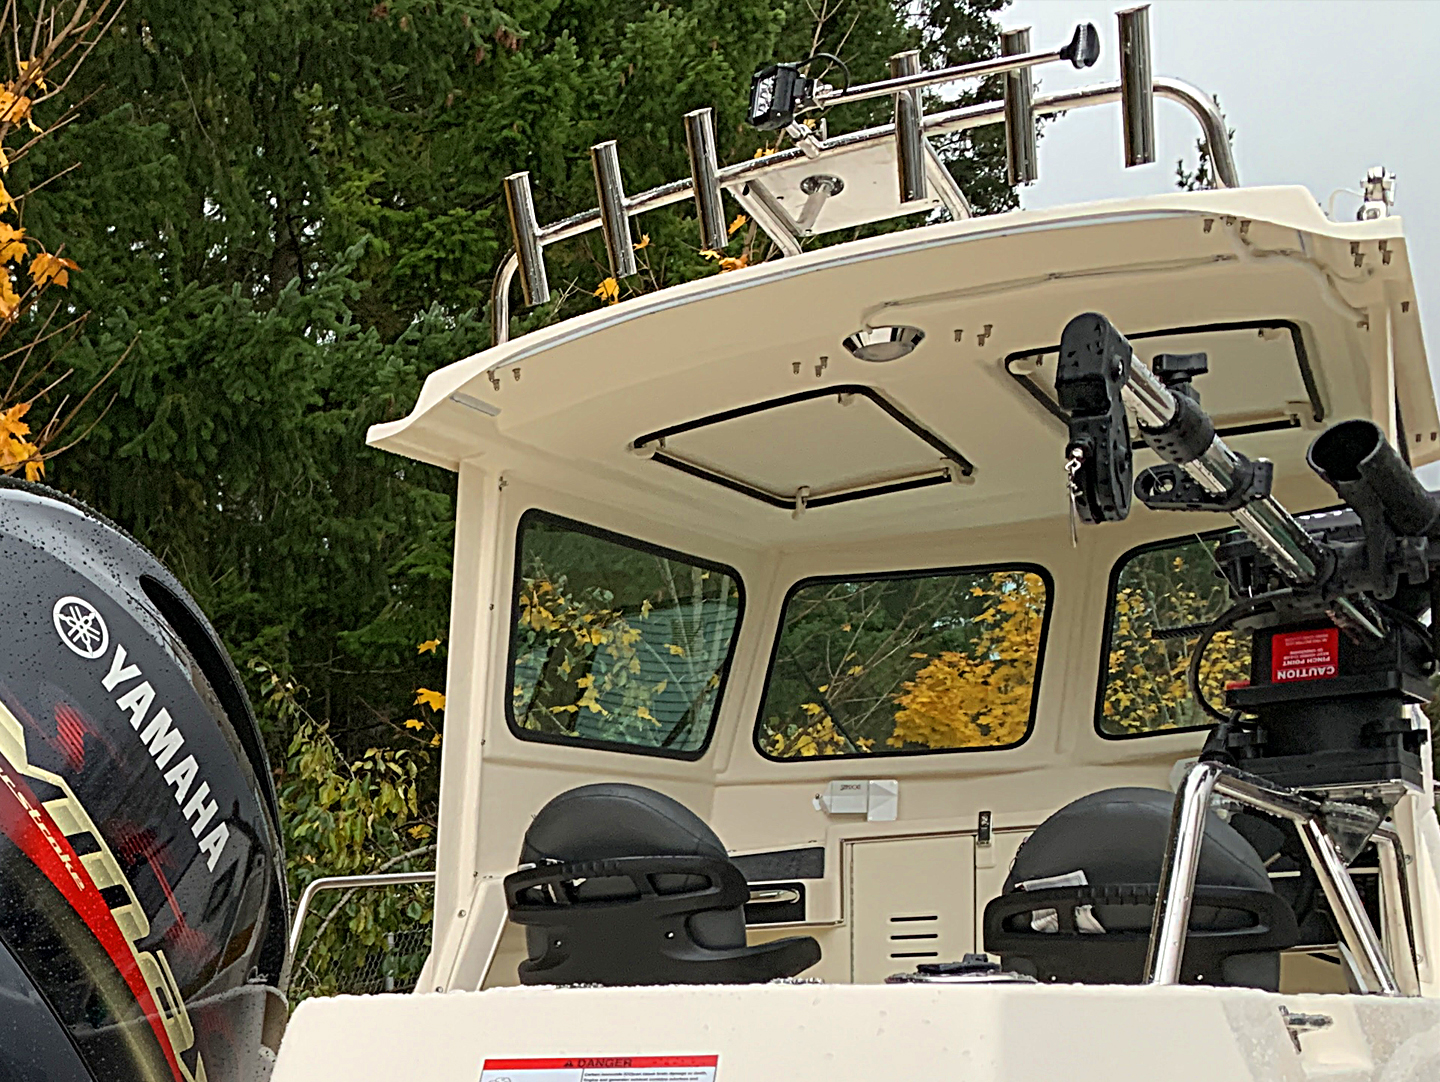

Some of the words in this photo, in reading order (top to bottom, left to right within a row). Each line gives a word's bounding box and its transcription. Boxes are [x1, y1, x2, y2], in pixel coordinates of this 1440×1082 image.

[1282, 658, 1306, 667] POINT
[1306, 656, 1331, 664] PINCH
[1277, 666, 1335, 680] CAUTION
[101, 644, 229, 872] YAMAHA
[577, 1058, 632, 1068] DANGER
